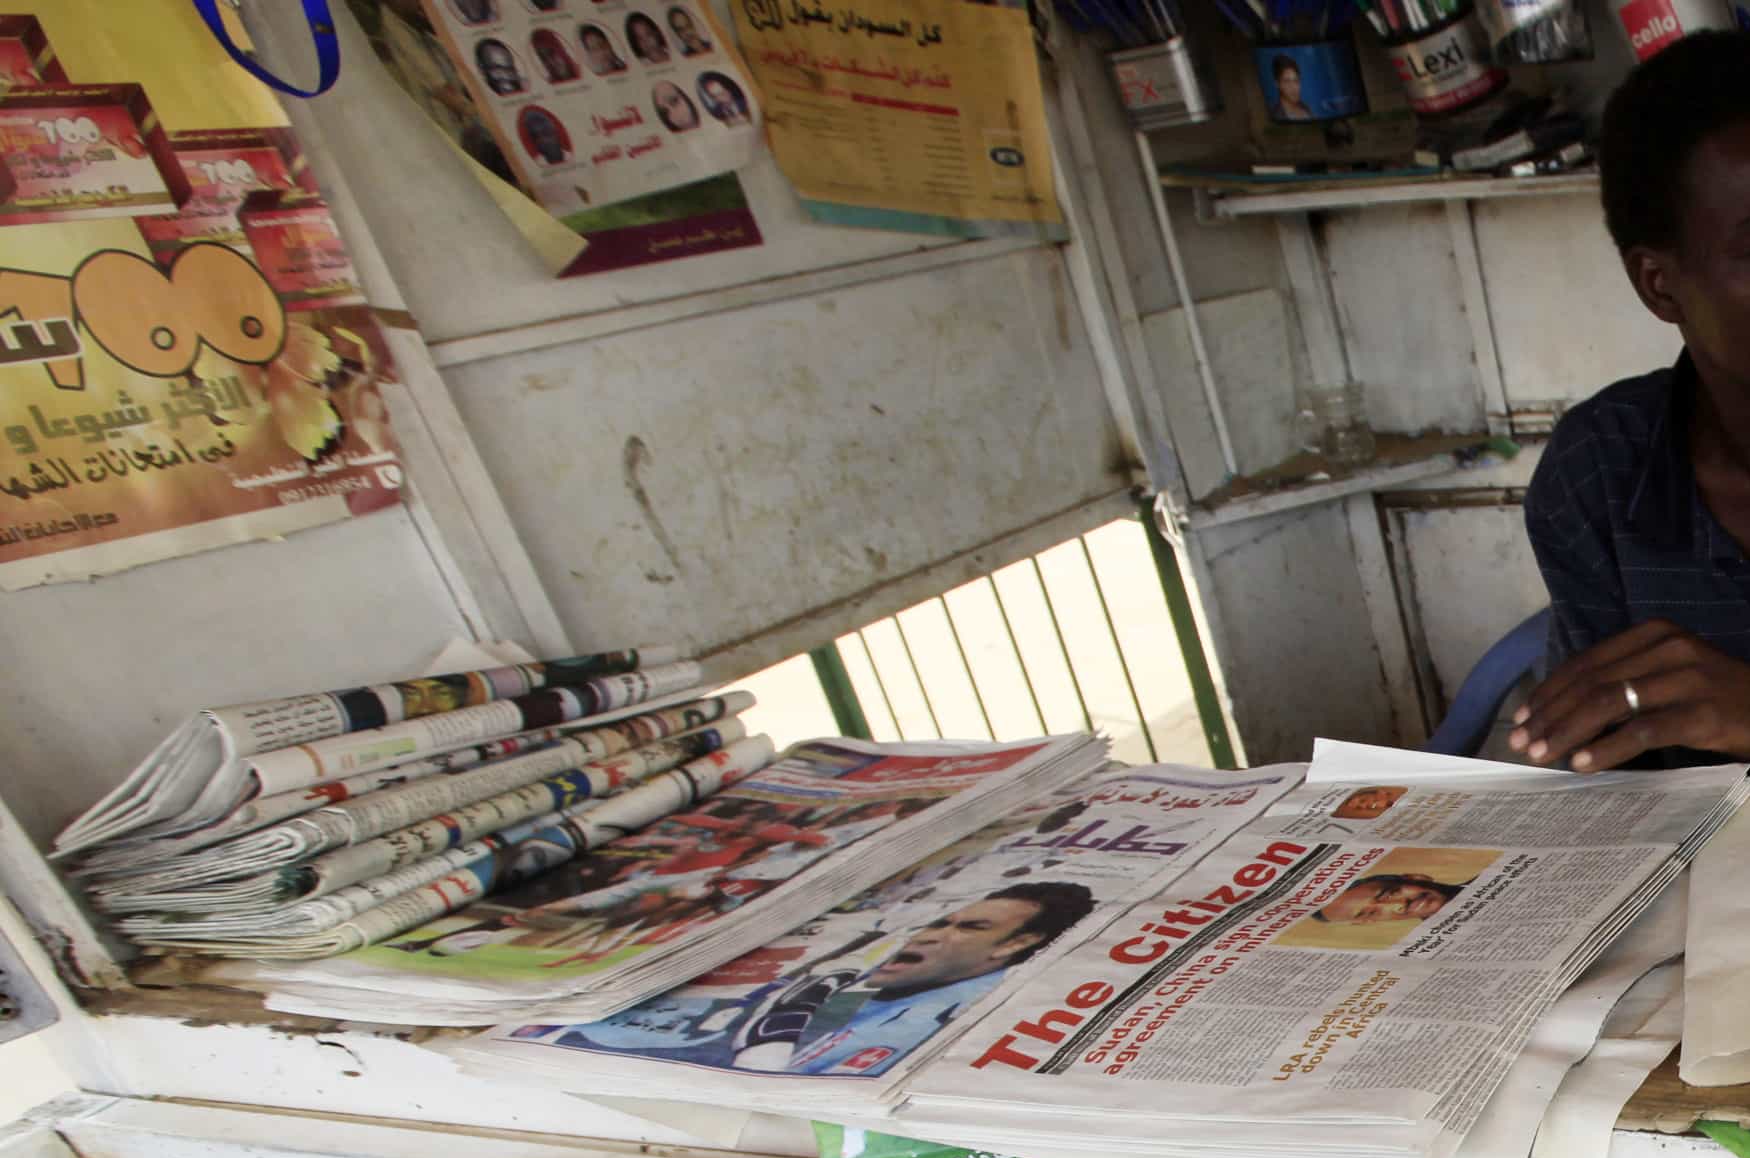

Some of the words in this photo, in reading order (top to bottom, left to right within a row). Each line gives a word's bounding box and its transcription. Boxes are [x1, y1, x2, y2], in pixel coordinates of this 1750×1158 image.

[970, 979, 1115, 1078] The
[1108, 840, 1309, 967] Citizen
[1085, 1000, 1161, 1064] Sudan,
[1154, 953, 1217, 1002] China
[1214, 919, 1258, 955] sign
[1256, 851, 1355, 924] cooperation
[1103, 978, 1219, 1083] agreement
[1215, 956, 1240, 978] on
[1239, 907, 1310, 961] mineral
[1303, 845, 1385, 915] resources
[1272, 1053, 1308, 1081] LRA
[1302, 1007, 1345, 1049] rebels
[1338, 969, 1392, 1007] hunted
[1302, 1033, 1341, 1074] down
[1332, 1016, 1354, 1031] in
[1349, 975, 1401, 1015] Central
[1346, 1001, 1389, 1040] Africa
